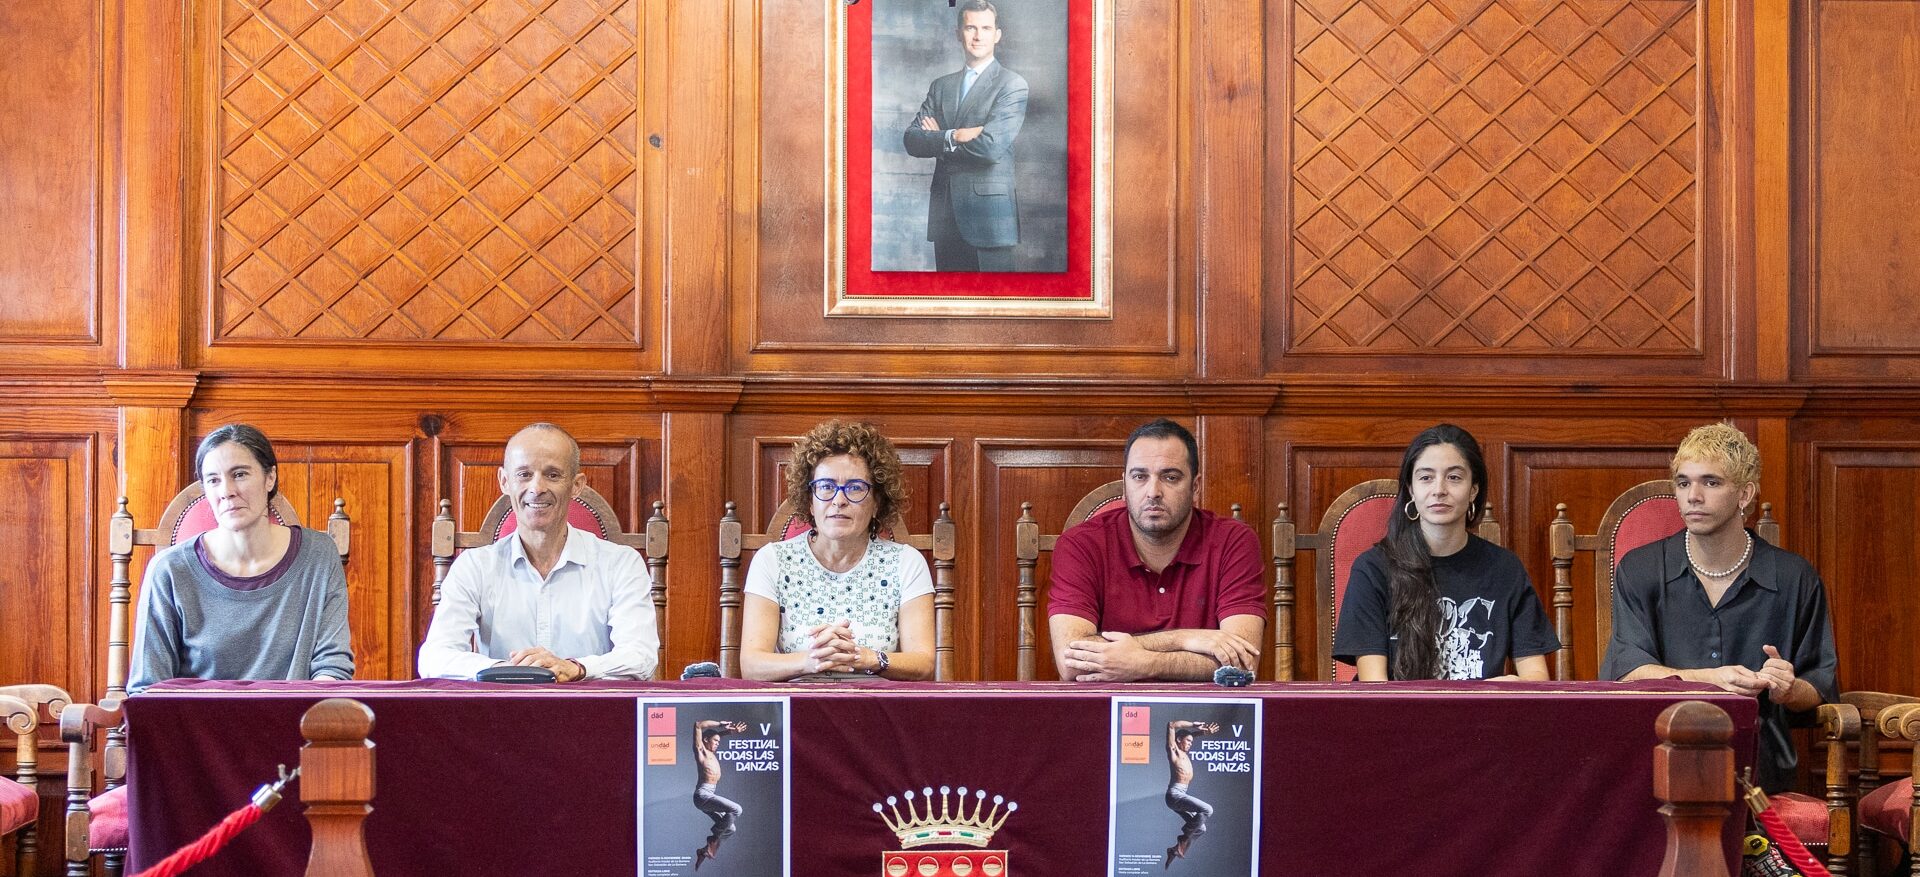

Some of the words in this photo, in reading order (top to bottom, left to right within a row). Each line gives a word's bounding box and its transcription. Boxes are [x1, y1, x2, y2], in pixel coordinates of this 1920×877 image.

[759, 723, 771, 736] V
[1231, 724, 1243, 738] V
[728, 739, 780, 750] FESTIVAL
[1201, 740, 1251, 751] FESTIVAL
[716, 750, 753, 761] TODAS
[753, 750, 775, 761] LAS
[1188, 751, 1225, 761] TODAS
[1225, 751, 1246, 762] LAS
[735, 761, 780, 771] DANZAS
[1207, 762, 1251, 773] DANZAS
